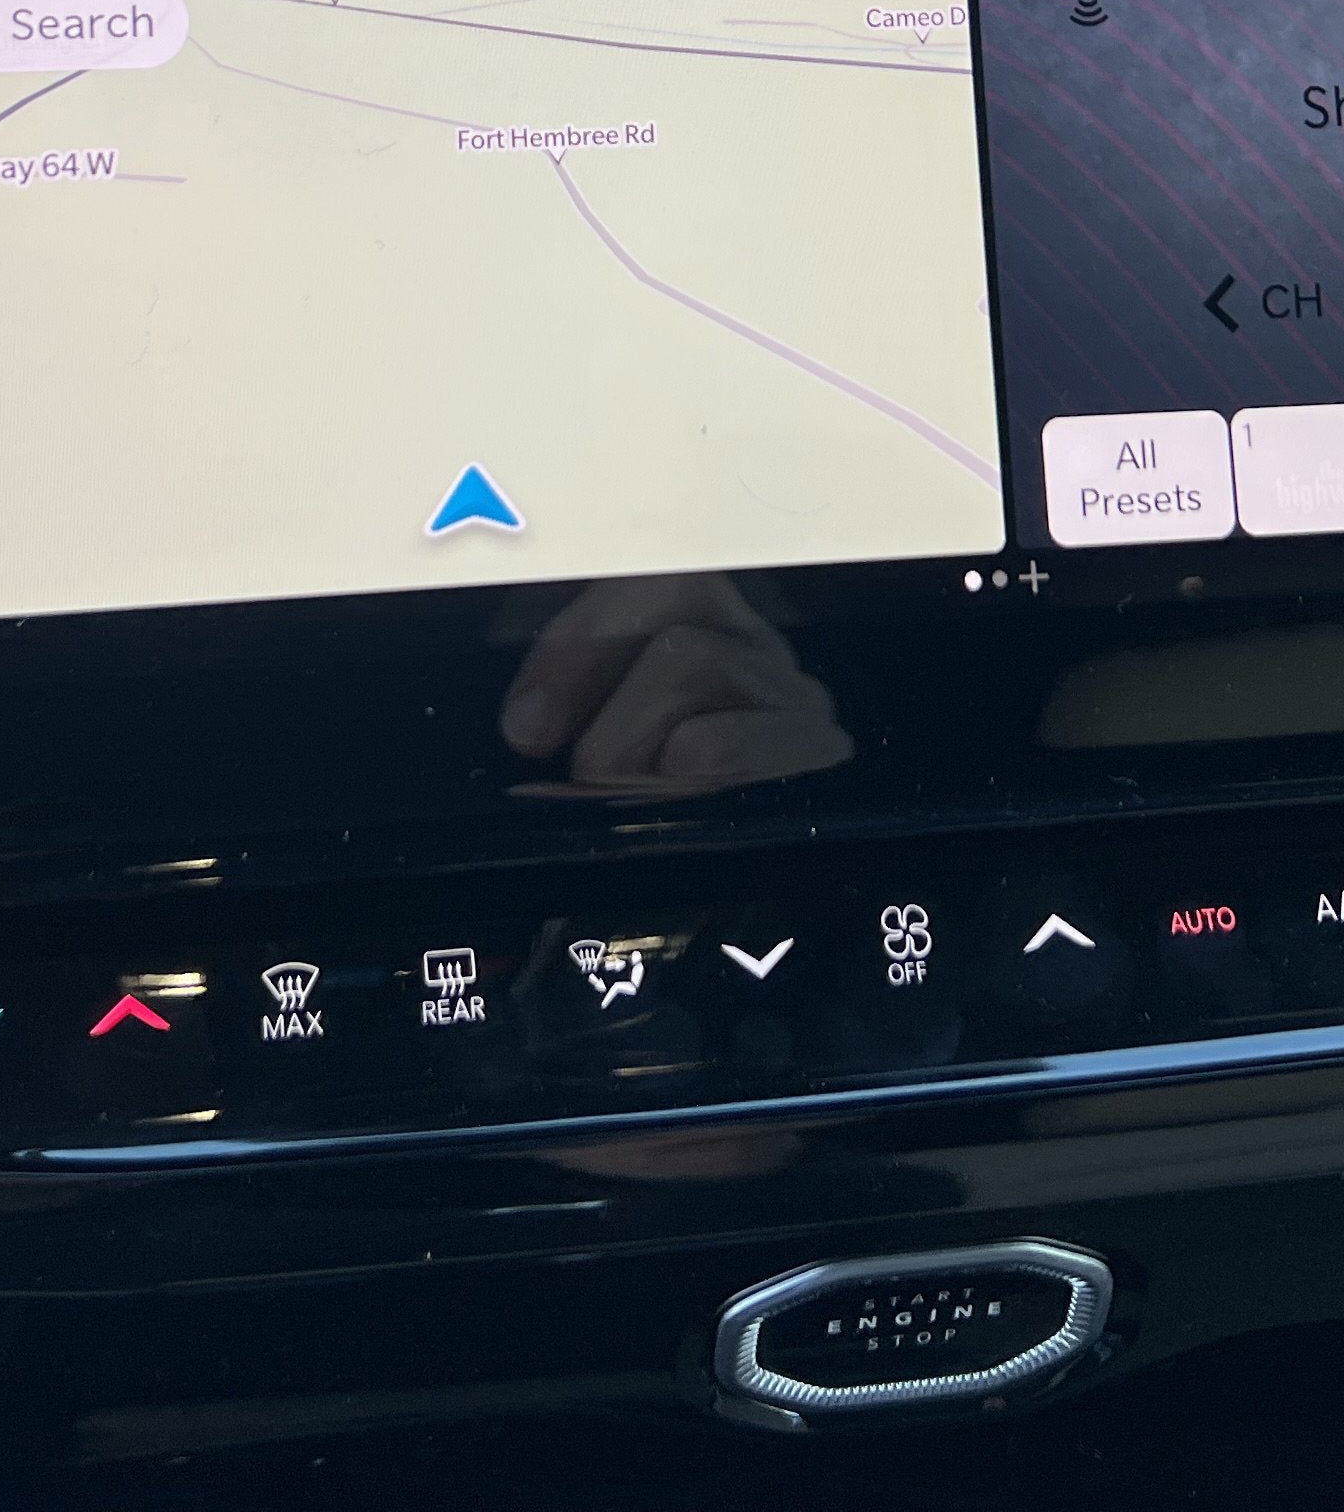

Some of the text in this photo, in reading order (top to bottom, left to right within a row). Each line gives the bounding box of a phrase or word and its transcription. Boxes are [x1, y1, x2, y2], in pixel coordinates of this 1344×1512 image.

[11, 4, 155, 41] Search
[866, 8, 944, 28] Cameo
[457, 123, 655, 152] Fort Hembree Rd
[42, 152, 80, 178] 64
[86, 151, 116, 176] W
[1261, 283, 1324, 320] CH
[1243, 423, 1254, 448] 1
[1116, 438, 1157, 472] All
[1079, 484, 1203, 519] Presets
[1169, 903, 1237, 937] AUTO
[886, 958, 929, 986] OFF
[261, 1009, 325, 1041] MAX
[420, 993, 487, 1026] REAR
[863, 1287, 975, 1310] START
[827, 1300, 1004, 1336] ENGINE
[866, 1328, 958, 1353] STOP
